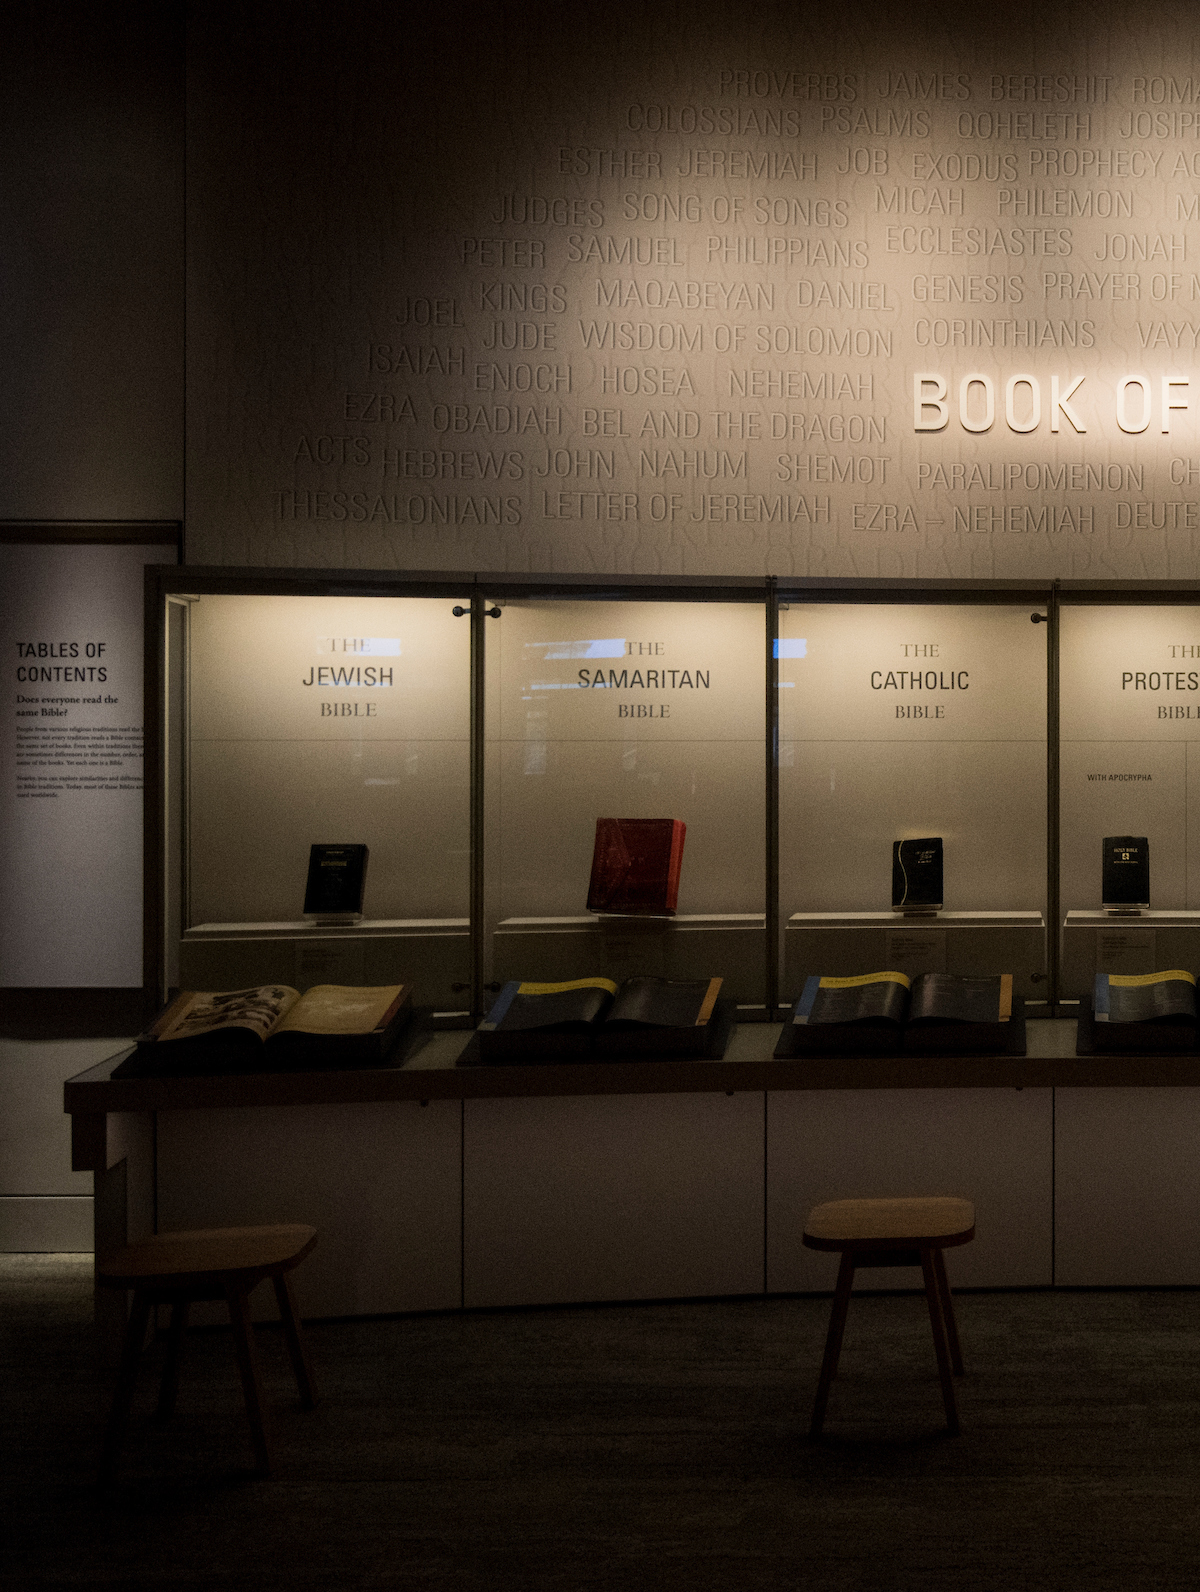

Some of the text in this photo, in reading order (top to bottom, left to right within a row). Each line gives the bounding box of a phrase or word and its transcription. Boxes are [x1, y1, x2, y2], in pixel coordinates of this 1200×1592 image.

[989, 74, 1112, 101] BERESHIT
[820, 108, 930, 138] PSALMS
[958, 112, 1092, 141] QOHELETH
[676, 149, 819, 180] JEREMIAH
[836, 148, 889, 176] JOB
[911, 152, 1019, 182] EXODUS
[1029, 149, 1162, 180] PROPHECY
[622, 194, 850, 228] SONG OF SONGS
[875, 186, 966, 215] MICAH
[998, 189, 1134, 219] PHILEMON
[568, 235, 686, 266] SAMUEL
[706, 237, 870, 268] PHILIPPIANS
[885, 228, 1073, 258] ECCLESIASTES
[1094, 232, 1186, 261] JONAH
[479, 282, 567, 313] KINGS
[595, 280, 775, 311] MAQABEYAN
[797, 280, 894, 311] DANIEL
[912, 274, 1024, 303] GENESIS
[1044, 272, 1141, 300] PRAYER
[1150, 274, 1181, 300] OF
[482, 320, 556, 351] JUDE
[578, 321, 894, 357] WISDOM OF SOLOMON
[914, 318, 1096, 349] CORINTHIANS
[474, 362, 573, 393] ENOCH
[601, 366, 696, 395] HOSEA
[728, 369, 875, 401] NEHEMIAH
[432, 402, 561, 434] OBADIAH
[912, 373, 1086, 435] BOOK
[1116, 373, 1191, 435] OF
[581, 409, 886, 443] BEL AND THE DRAGON
[382, 449, 525, 479] HEBREWS
[536, 449, 616, 479] JOHN
[639, 448, 748, 479] NAHUM
[777, 454, 891, 484] SHEMOT
[917, 461, 1144, 491] PARALIPOMENON
[272, 490, 523, 524] THESSALONIANS
[542, 491, 832, 524] LETTER OF JEREMIAH
[852, 502, 919, 532] EZRA
[952, 506, 1096, 534] NEHEMIAH
[16, 642, 106, 658] TABLES OF
[327, 638, 371, 652] THE
[626, 641, 665, 656] THE
[901, 643, 940, 658] THE
[17, 666, 108, 682] CONTENTS
[303, 667, 393, 687] JEWISH
[577, 669, 711, 689] SAMARITAN
[870, 670, 970, 691] CATHOLIC
[16, 695, 118, 706] Does everyone read the
[16, 708, 68, 717] same Bible?
[320, 702, 377, 718] BIBLE
[618, 704, 670, 719] BIBLE
[895, 705, 945, 720] BIBLE
[1087, 774, 1152, 782] WITH APOCRYPHA
